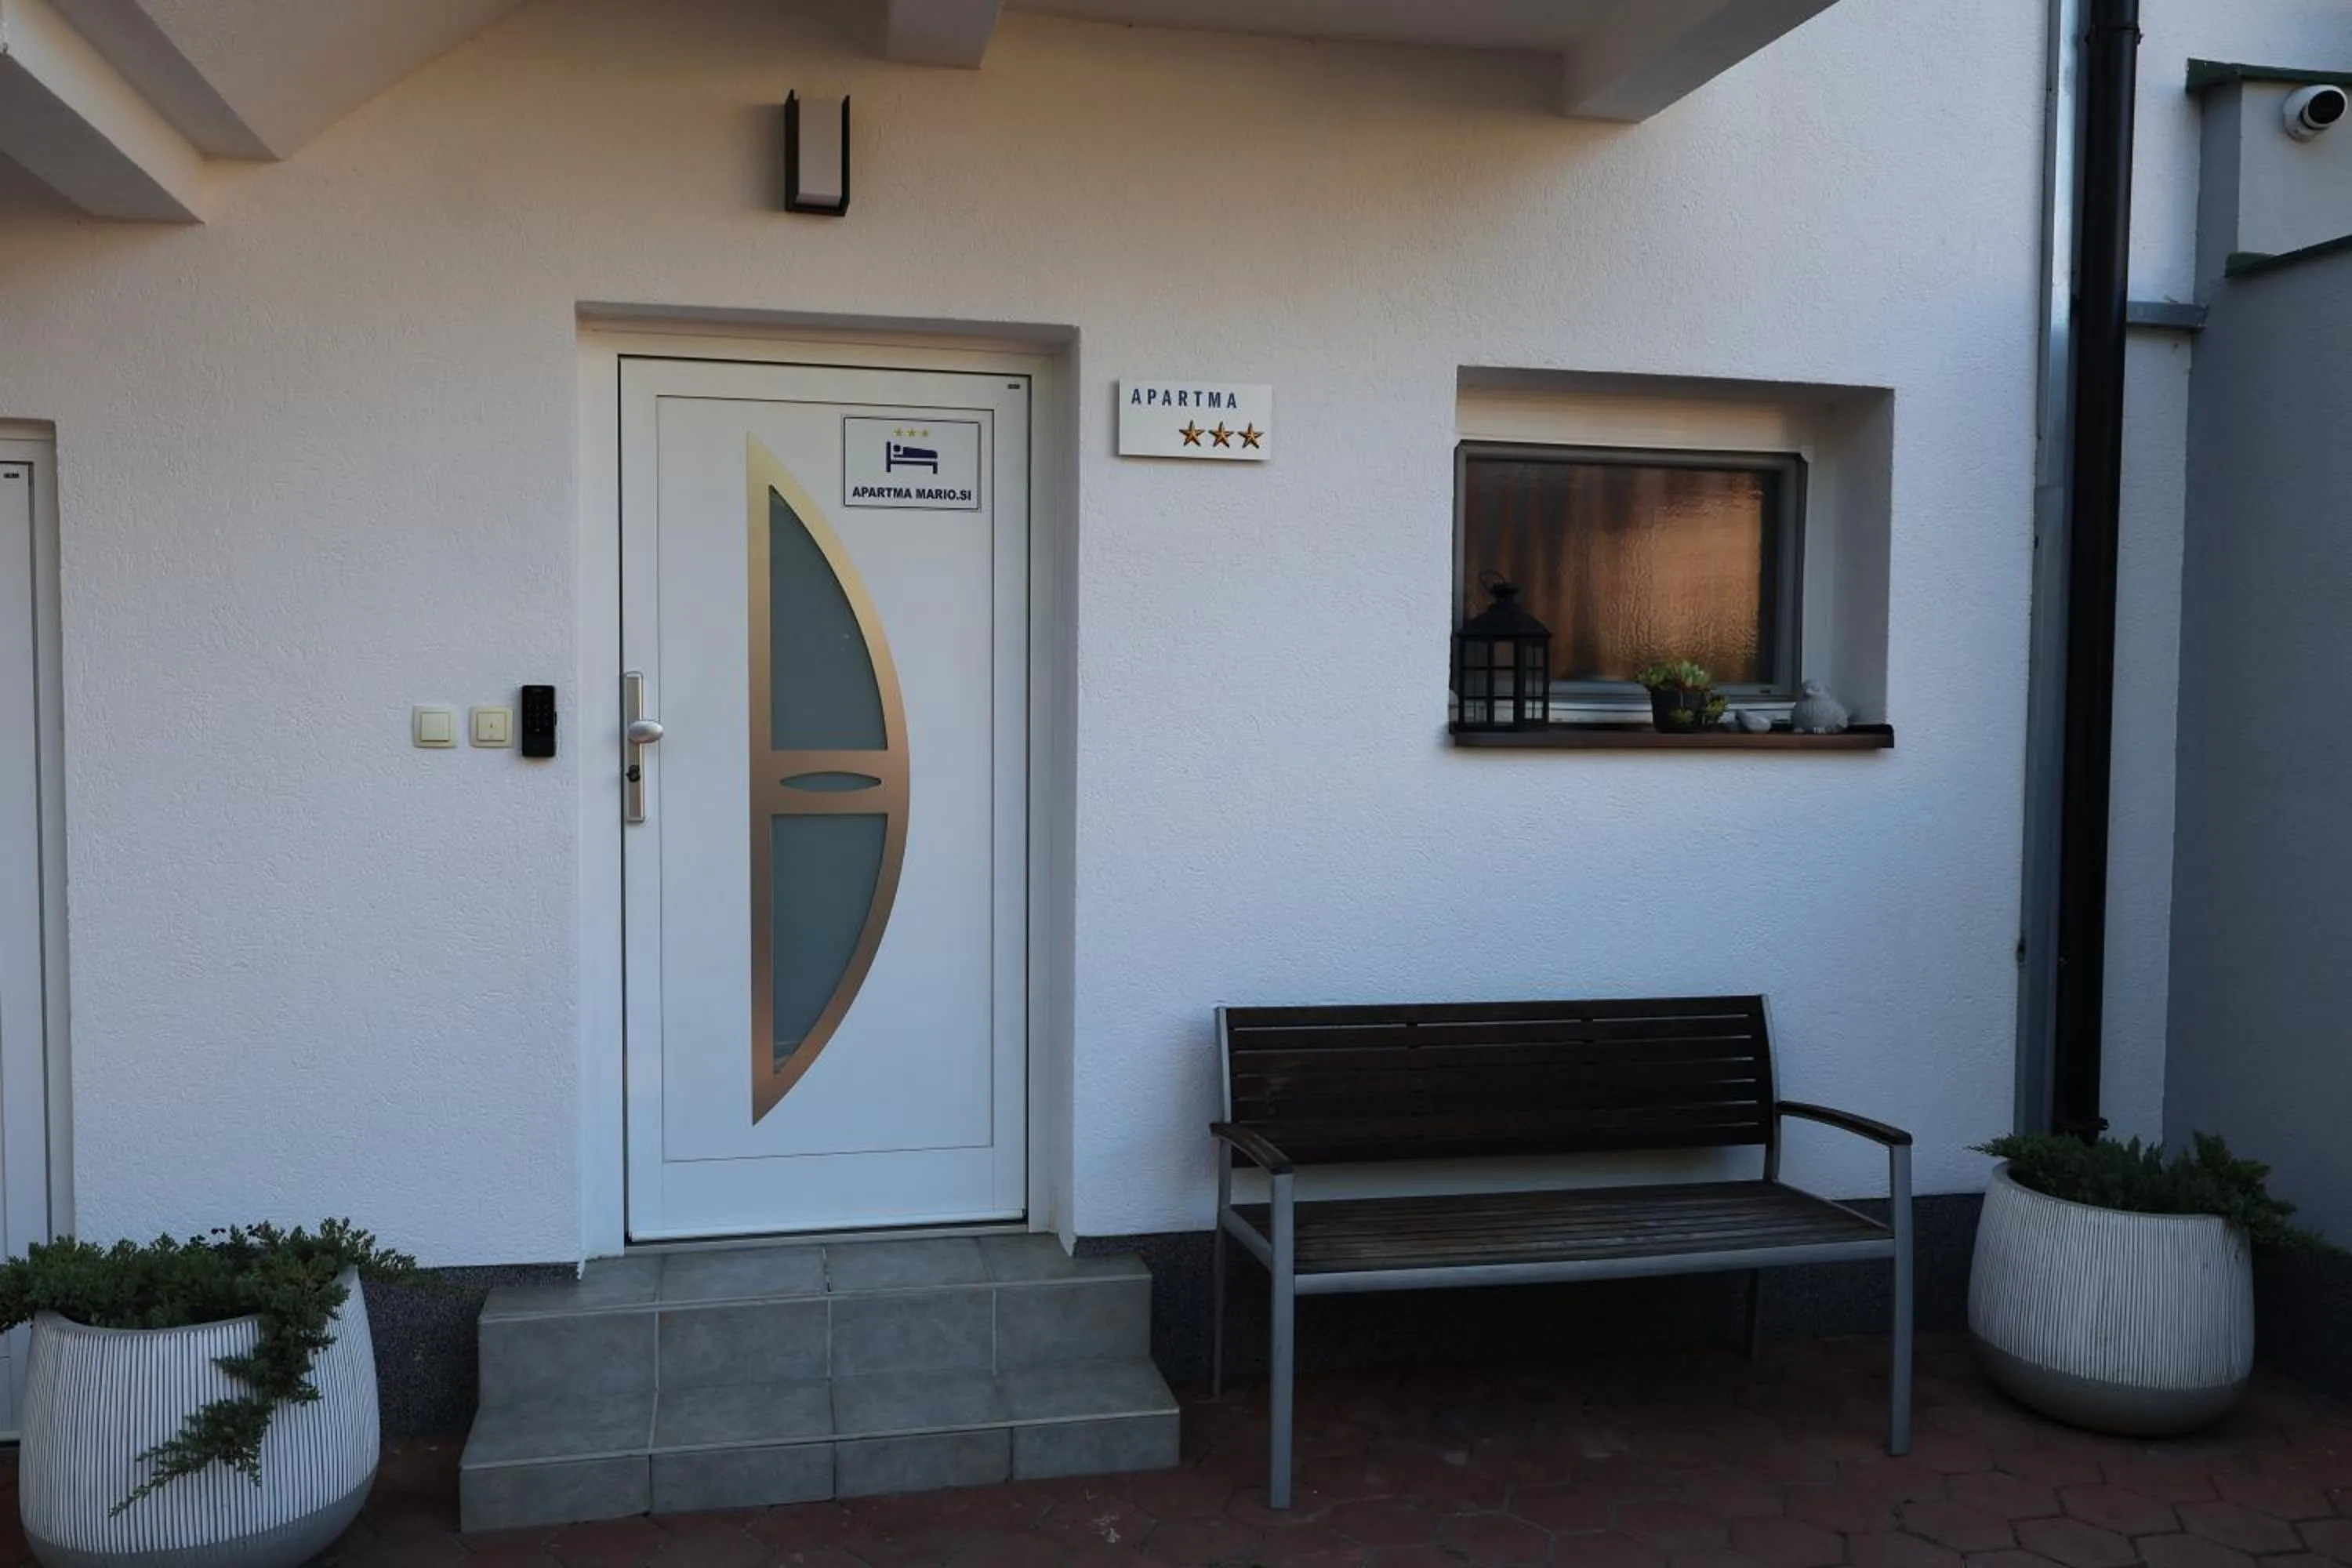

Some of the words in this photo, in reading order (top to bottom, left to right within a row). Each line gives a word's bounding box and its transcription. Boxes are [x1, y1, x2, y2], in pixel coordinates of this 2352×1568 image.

[1131, 388, 1237, 408] APARTMA
[852, 486, 912, 499] APARTMA
[916, 488, 971, 501] MARIO.SI
